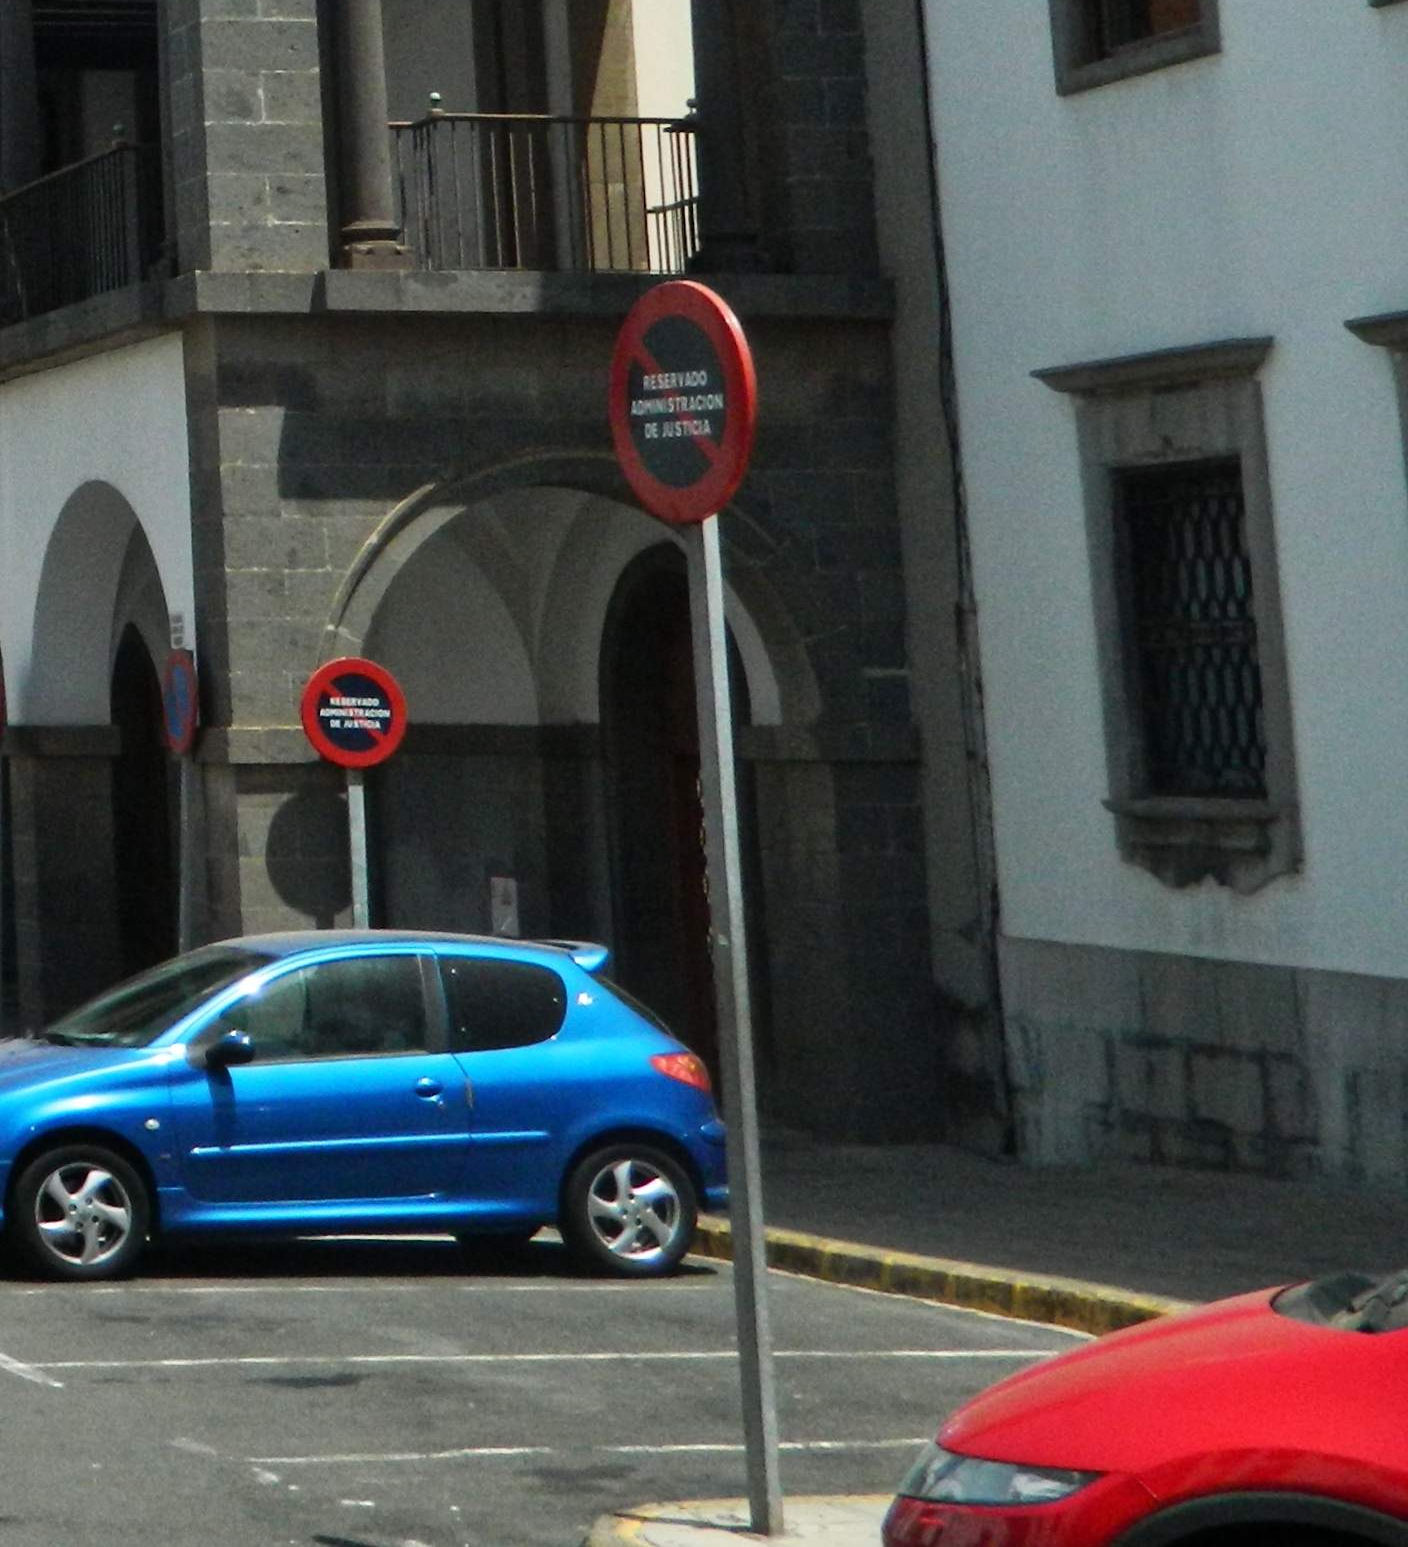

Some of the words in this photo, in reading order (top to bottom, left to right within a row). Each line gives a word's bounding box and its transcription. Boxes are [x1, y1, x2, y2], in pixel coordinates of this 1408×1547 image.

[643, 370, 708, 390] RESERVADO
[630, 393, 724, 416] ADMINISTRACION
[644, 422, 659, 439] DE
[662, 419, 712, 437] JUSTICIA
[329, 697, 380, 706] RESERVADO
[329, 719, 341, 728] DE
[344, 719, 381, 729] JUSTICIA
